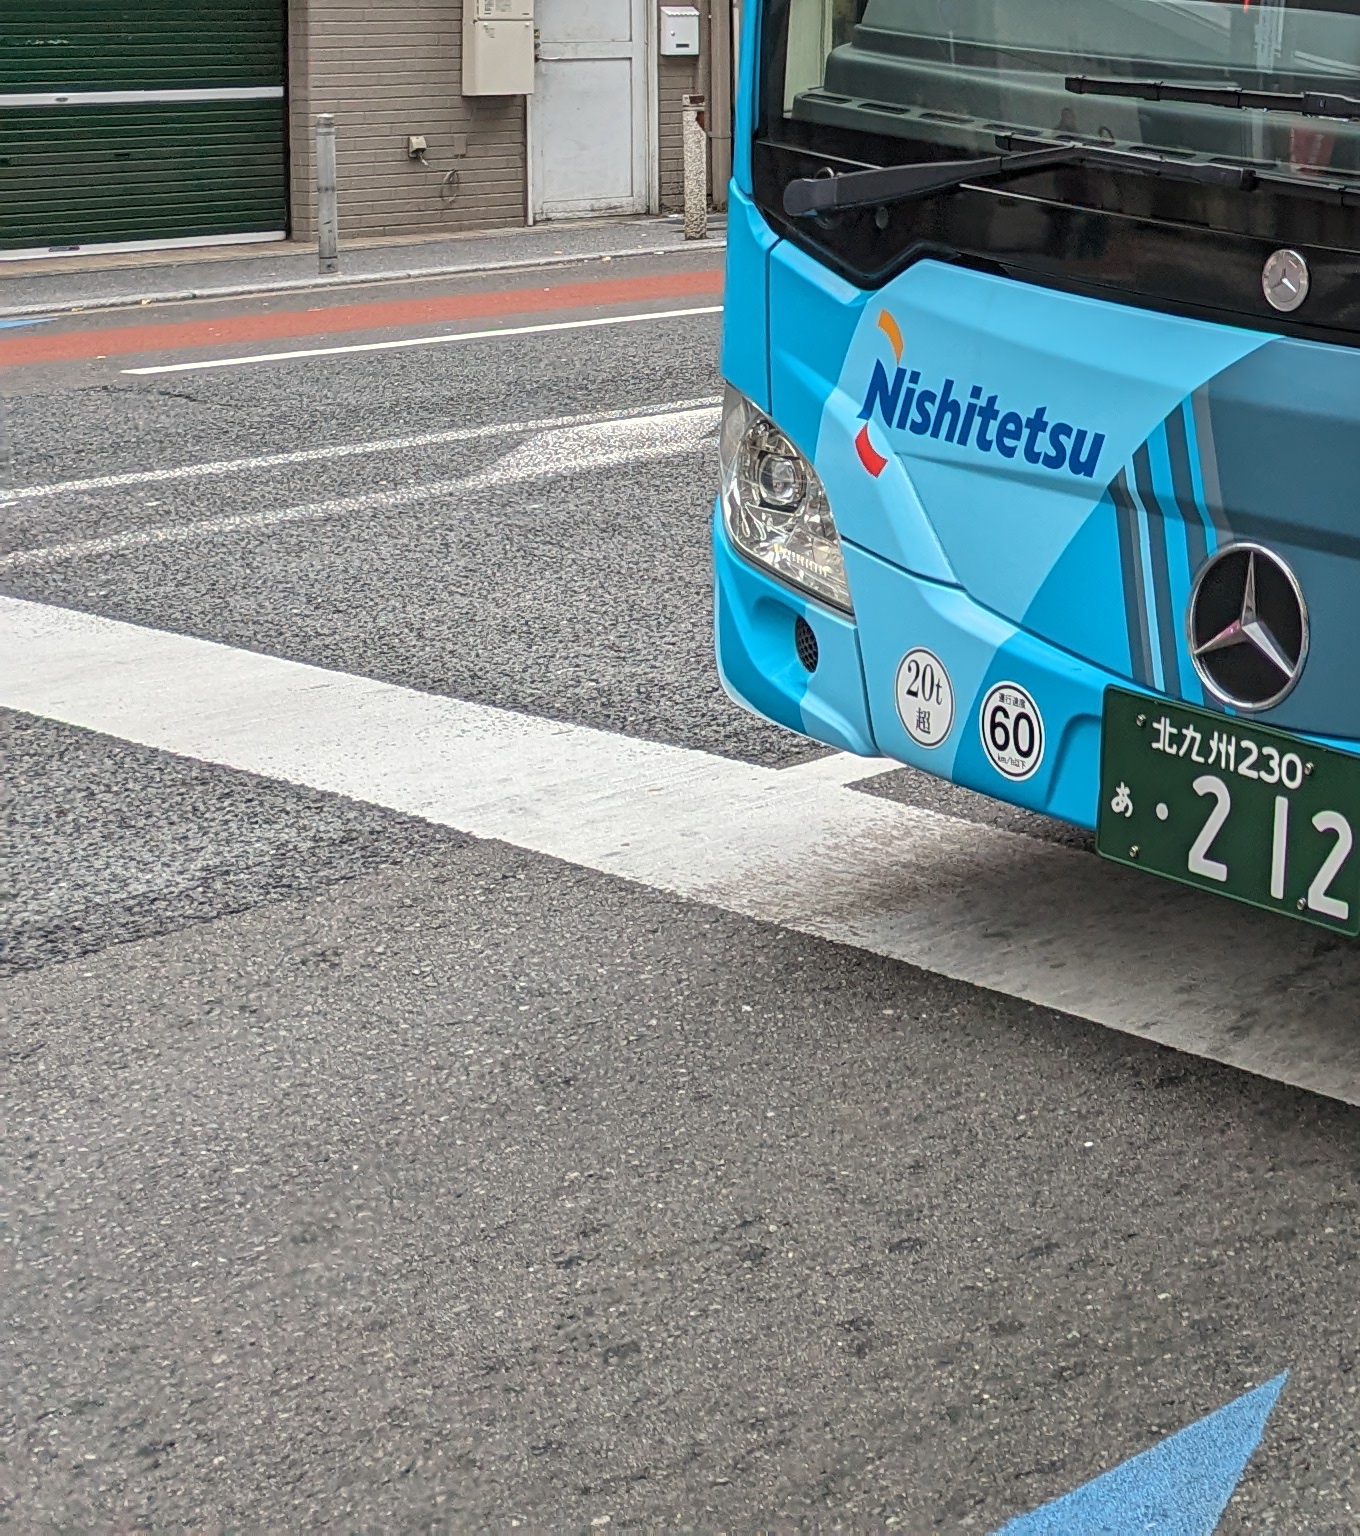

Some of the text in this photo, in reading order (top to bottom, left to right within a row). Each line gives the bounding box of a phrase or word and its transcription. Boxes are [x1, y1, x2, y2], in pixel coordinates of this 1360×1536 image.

[860, 358, 1105, 479] Nishitetsu
[906, 659, 942, 705] 20t
[915, 707, 931, 735] 超
[989, 705, 1035, 759] 60
[1110, 781, 1134, 818] あ
